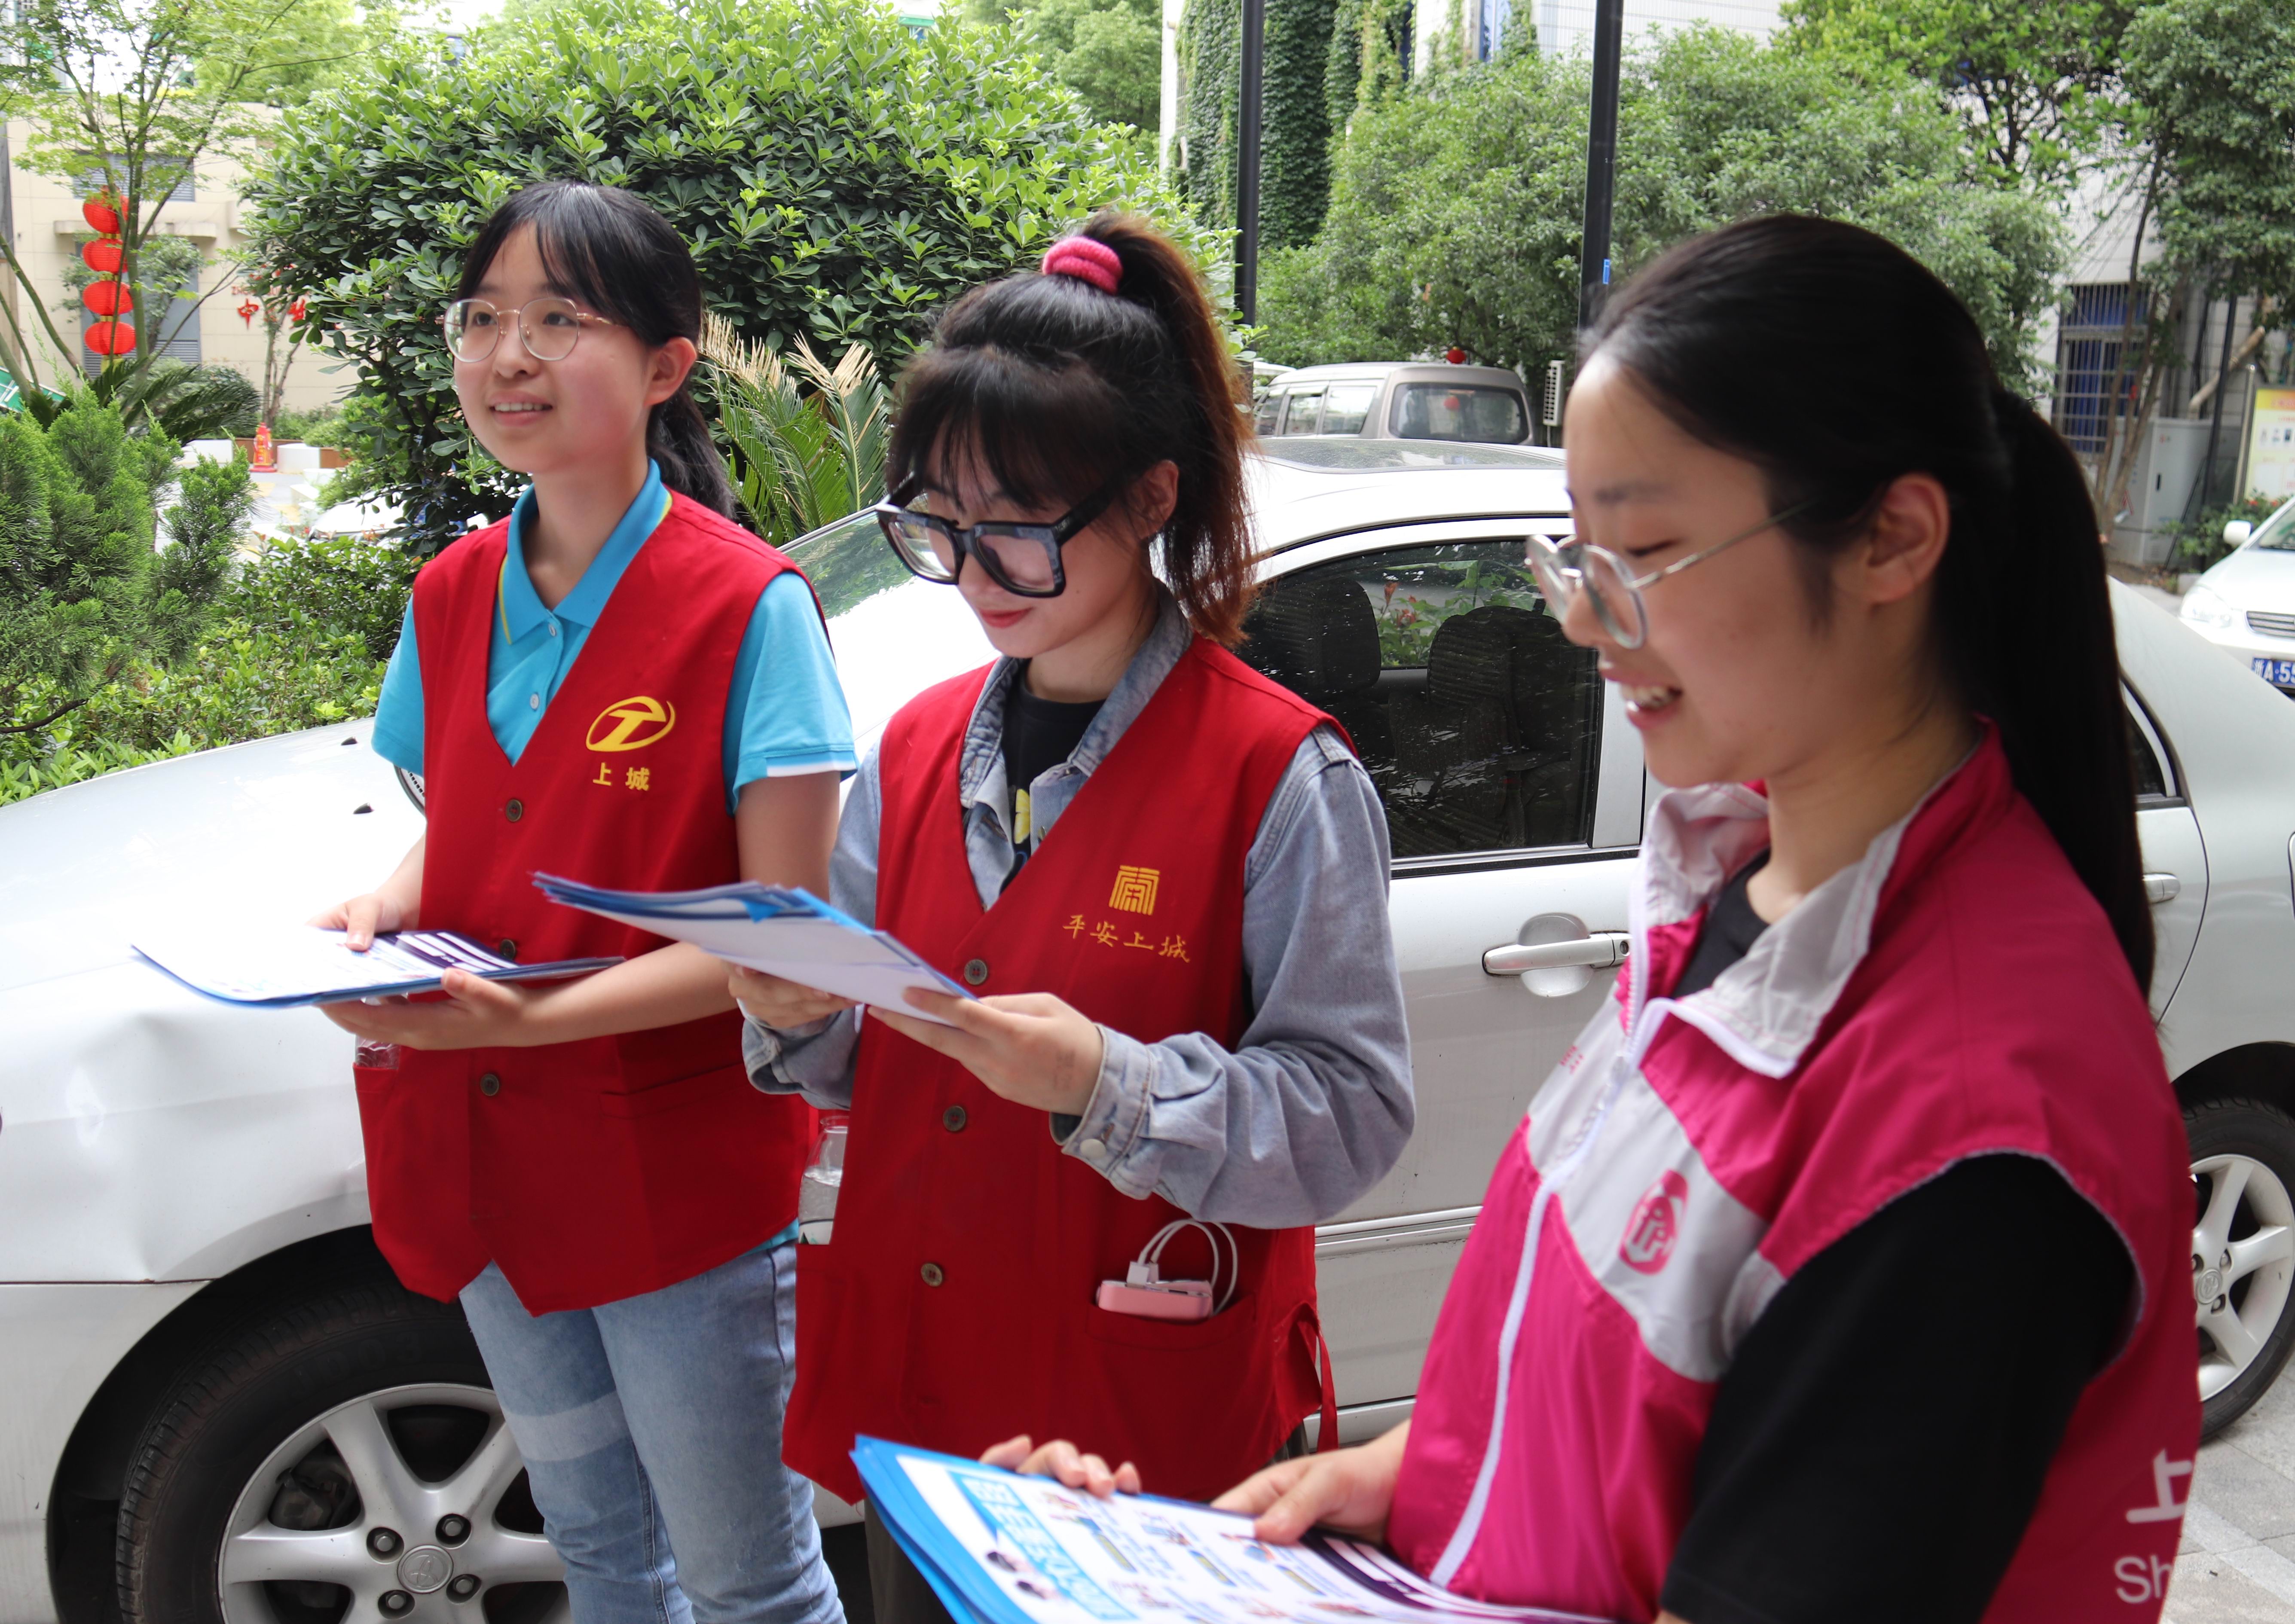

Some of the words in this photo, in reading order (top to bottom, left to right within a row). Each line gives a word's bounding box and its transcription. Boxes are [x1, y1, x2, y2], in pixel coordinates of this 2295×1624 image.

[593, 762, 650, 791] 上城
[1062, 914, 1190, 963] 平安上城
